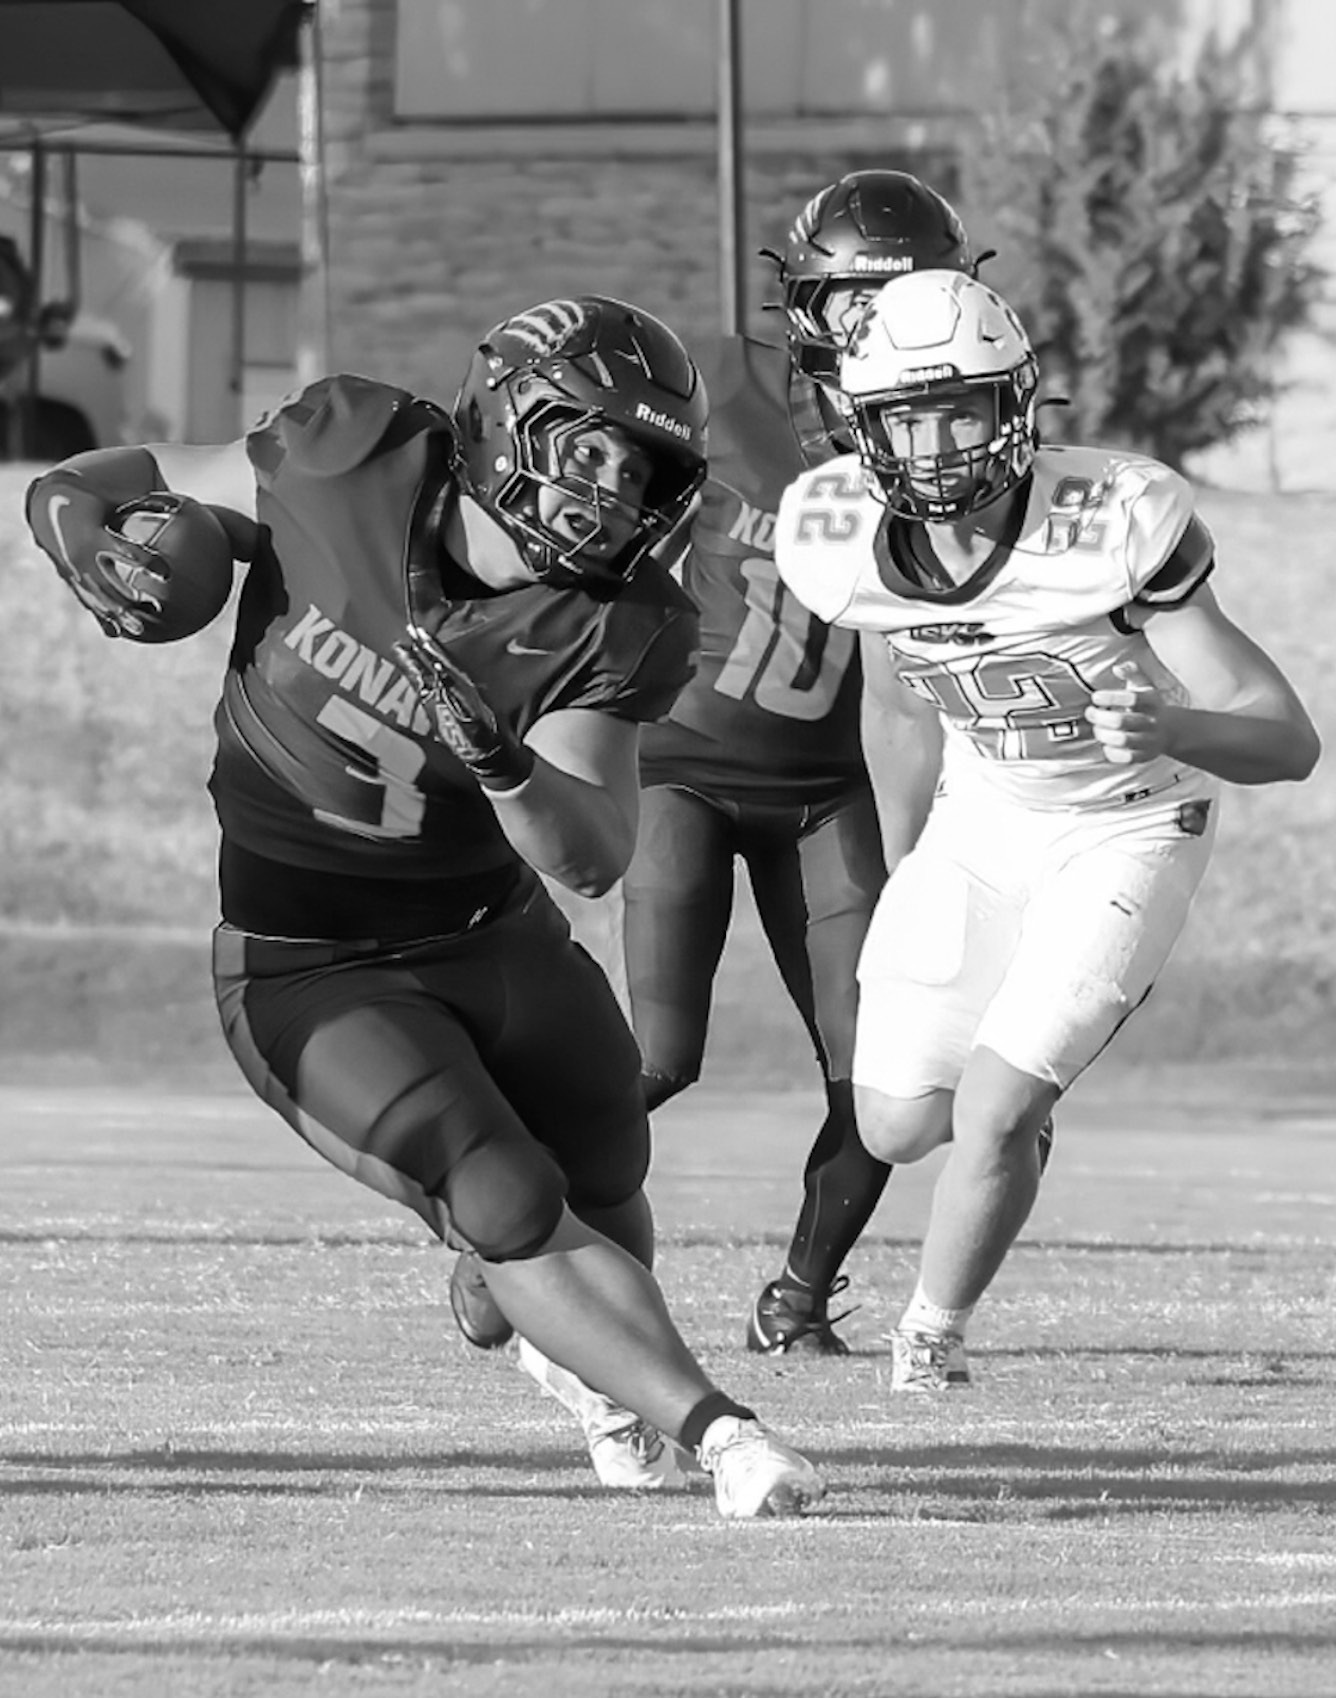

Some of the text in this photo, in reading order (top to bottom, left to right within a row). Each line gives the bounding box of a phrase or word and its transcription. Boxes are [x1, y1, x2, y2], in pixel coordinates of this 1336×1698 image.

[854, 254, 914, 272] Riddell
[634, 402, 692, 441] Riddell
[713, 556, 856, 721] 10
[315, 693, 427, 839] 3
